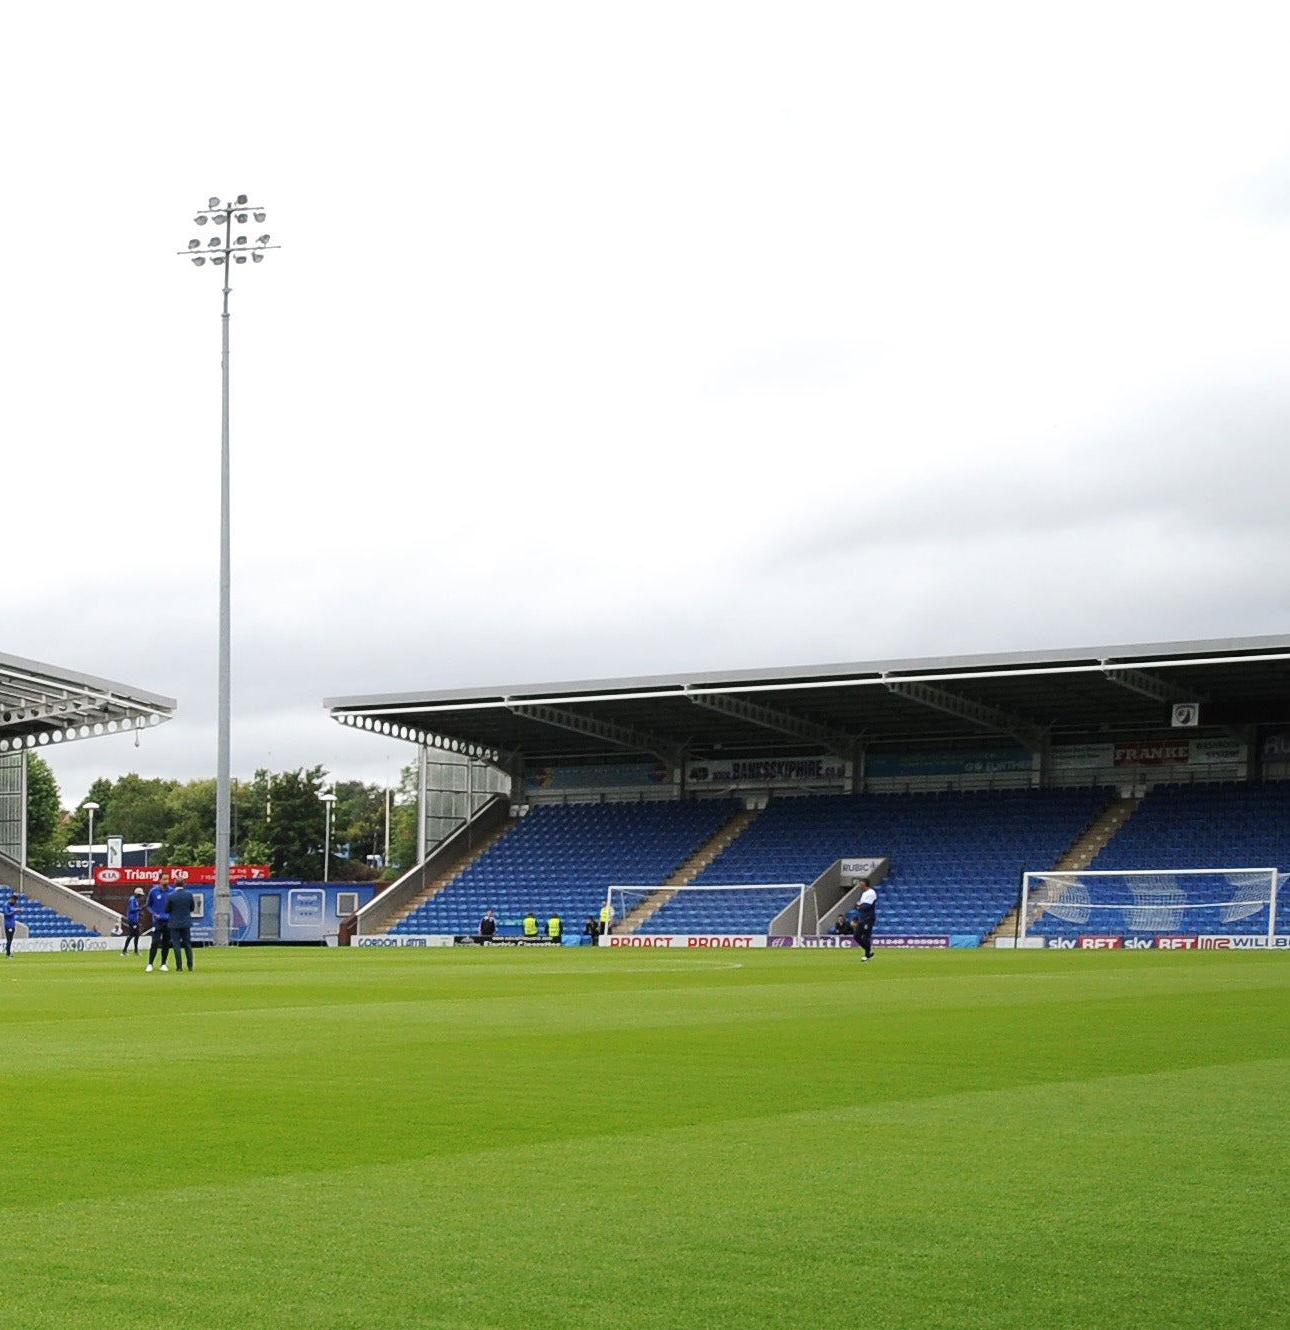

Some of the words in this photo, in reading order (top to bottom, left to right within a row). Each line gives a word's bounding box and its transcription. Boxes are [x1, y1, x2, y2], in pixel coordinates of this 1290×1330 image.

[1115, 747, 1189, 761] FRANKE
[101, 872, 118, 880] KIA
[124, 868, 162, 882] Triang
[171, 868, 189, 880] Kia
[84, 938, 108, 950] Group
[358, 938, 398, 947] GORDON
[610, 937, 673, 947] PROACT
[688, 937, 753, 947] PROACT
[792, 936, 852, 948] Ruttle
[1048, 936, 1077, 949] sky
[1082, 938, 1117, 949] BET
[1124, 936, 1153, 949] sky
[1159, 938, 1195, 949] BET
[1233, 938, 1290, 947] WILLB
